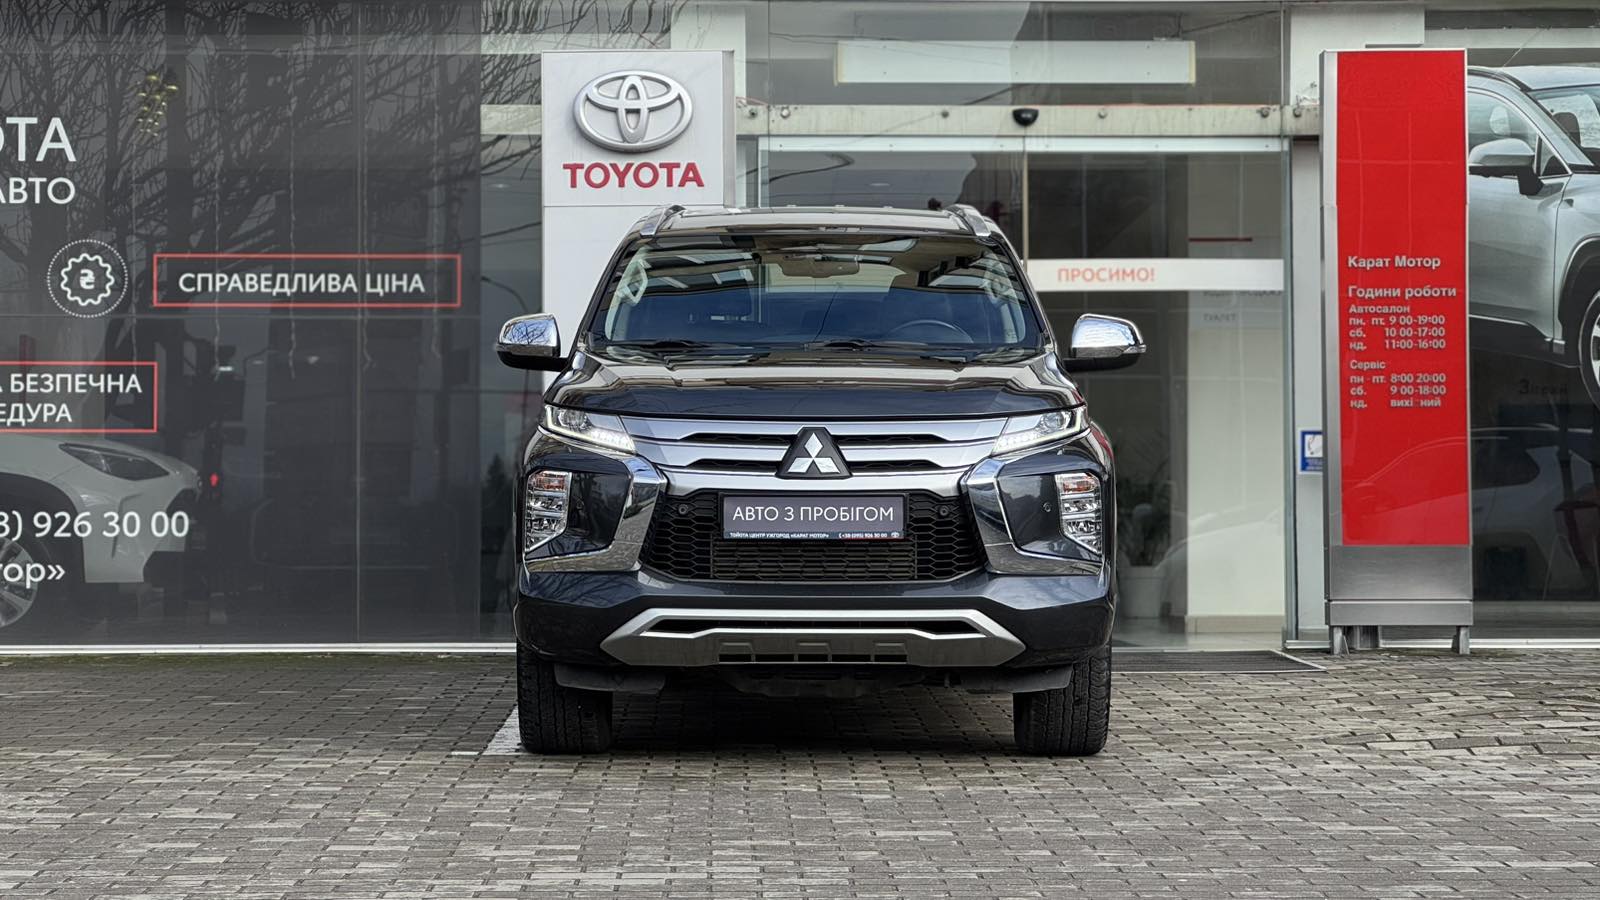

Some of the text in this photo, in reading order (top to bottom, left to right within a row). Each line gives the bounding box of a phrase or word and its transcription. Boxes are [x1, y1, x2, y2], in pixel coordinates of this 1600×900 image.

[0, 116, 77, 162] TA
[562, 162, 705, 189] TOYOTA
[1347, 255, 1441, 270] Карат Мотор
[1057, 267, 1156, 283] ПРОСИМО!
[178, 273, 425, 297] СПРАВЕДЛИВА ЦІНА
[1348, 286, 1457, 299] Години роботи
[1349, 304, 1411, 314] Автосалон
[1349, 327, 1366, 338] сб.
[1350, 359, 1387, 371] Сервіс
[10, 373, 142, 393] БЕЗПЕЧНА
[1390, 396, 1441, 407] вихіний
[732, 506, 779, 521] АВТО
[800, 506, 894, 521] ПРОБІГОМ
[33, 511, 93, 538] 926
[102, 511, 141, 538] 30
[150, 511, 190, 538] 00
[0, 562, 66, 589] ор»
